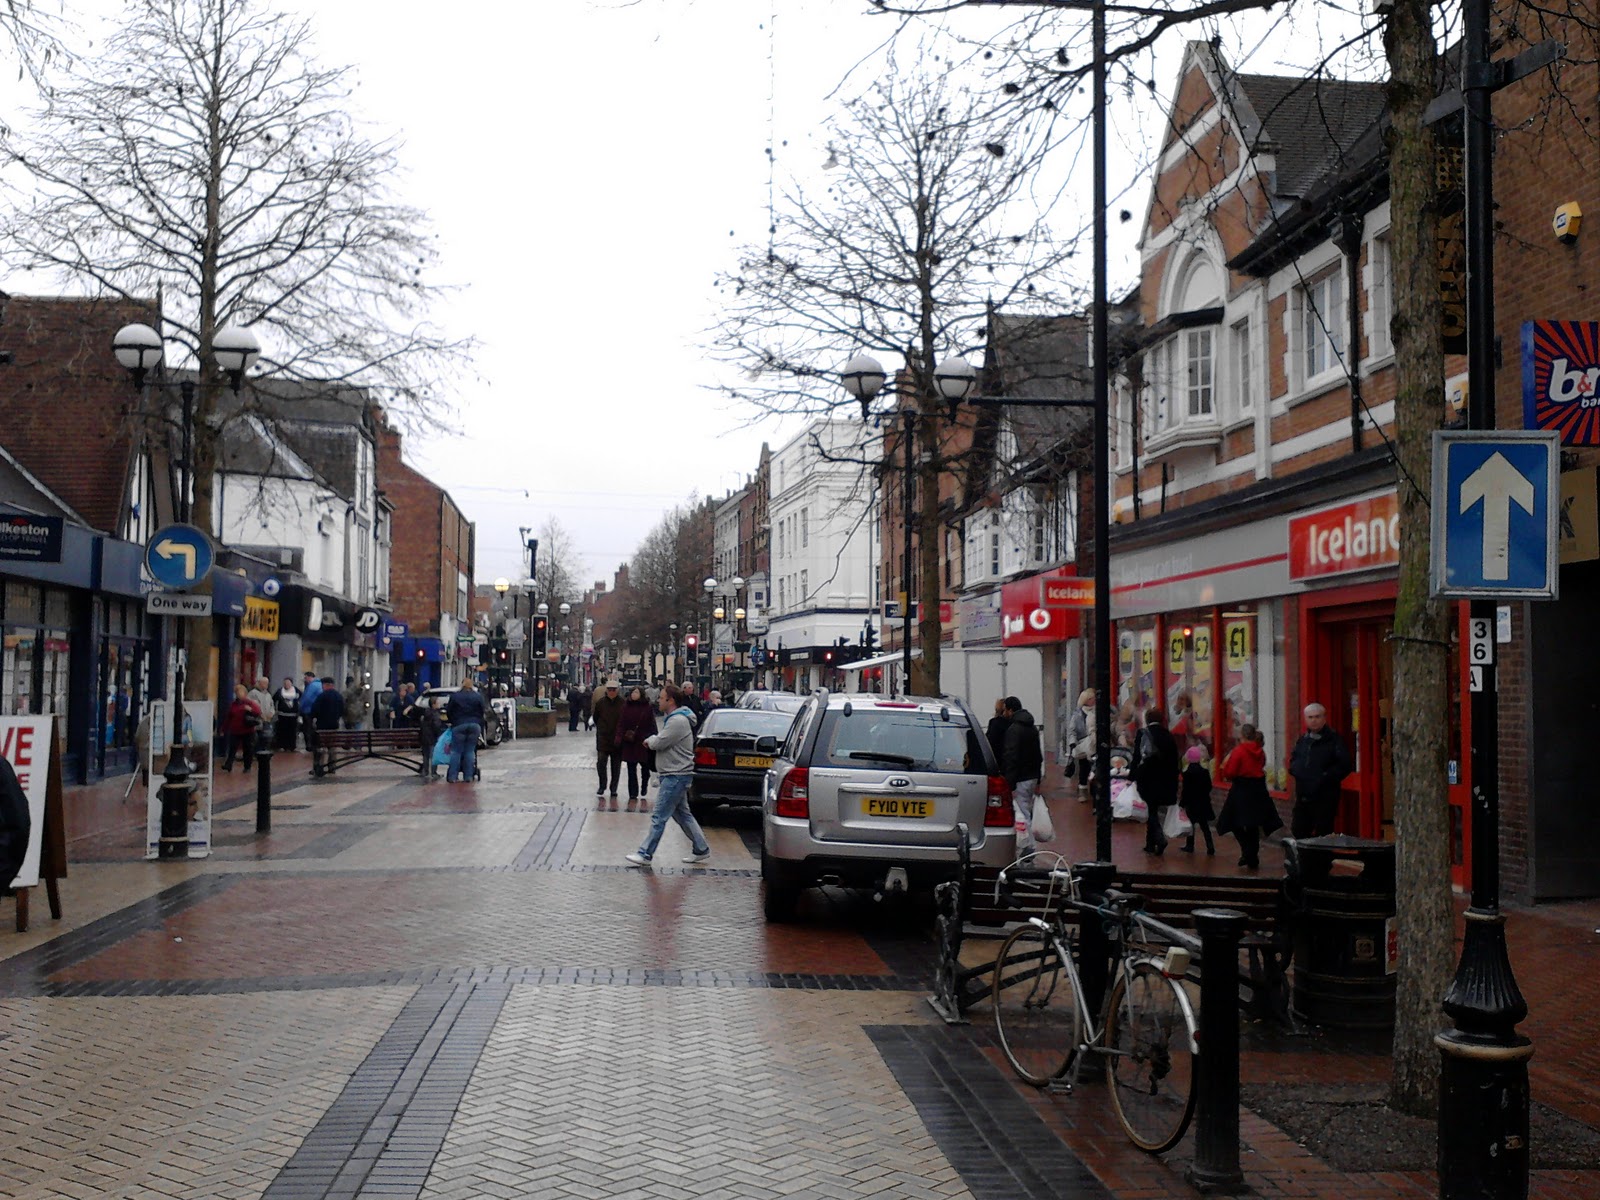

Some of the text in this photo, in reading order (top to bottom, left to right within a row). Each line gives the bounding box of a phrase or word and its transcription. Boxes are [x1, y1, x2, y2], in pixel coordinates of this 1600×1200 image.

[152, 597, 207, 612] One way
[355, 611, 379, 628] JD
[1230, 627, 1246, 658] £1
[869, 800, 927, 814] FY10 VTE
